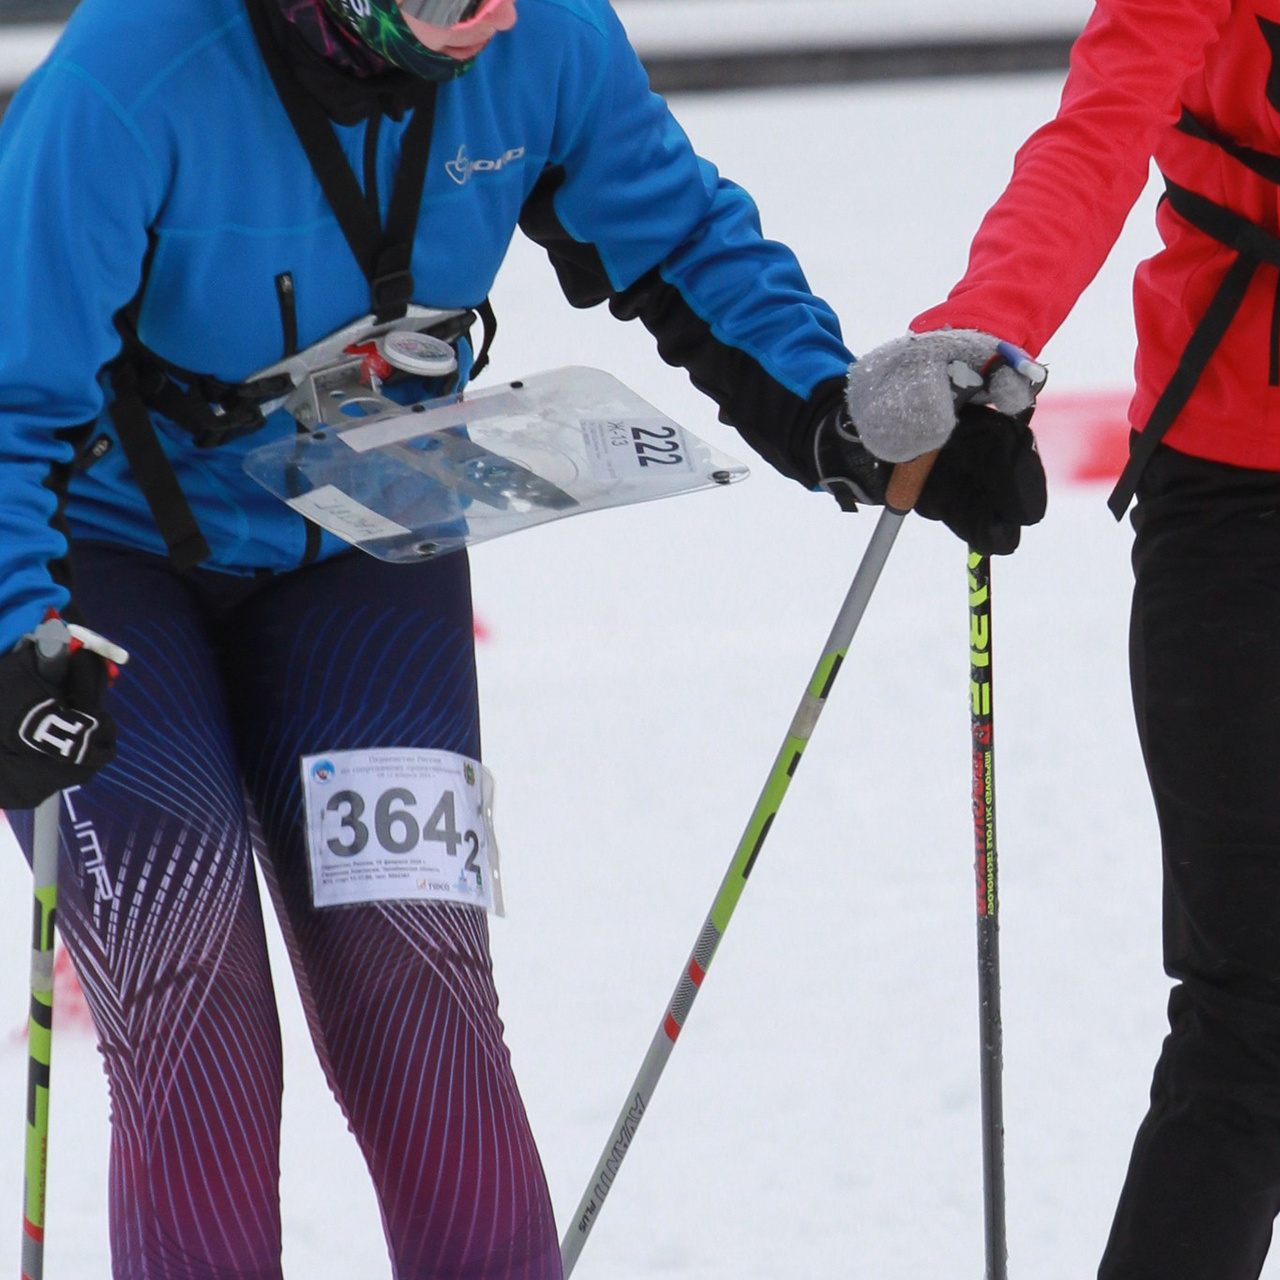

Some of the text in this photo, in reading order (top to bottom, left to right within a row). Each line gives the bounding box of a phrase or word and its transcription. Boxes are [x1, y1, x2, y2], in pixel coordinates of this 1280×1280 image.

[630, 426, 683, 467] 222
[984, 751, 993, 805] IMPROVED
[325, 787, 482, 873] 364 2
[986, 822, 994, 849] POLE
[578, 1199, 597, 1234] PLUS
